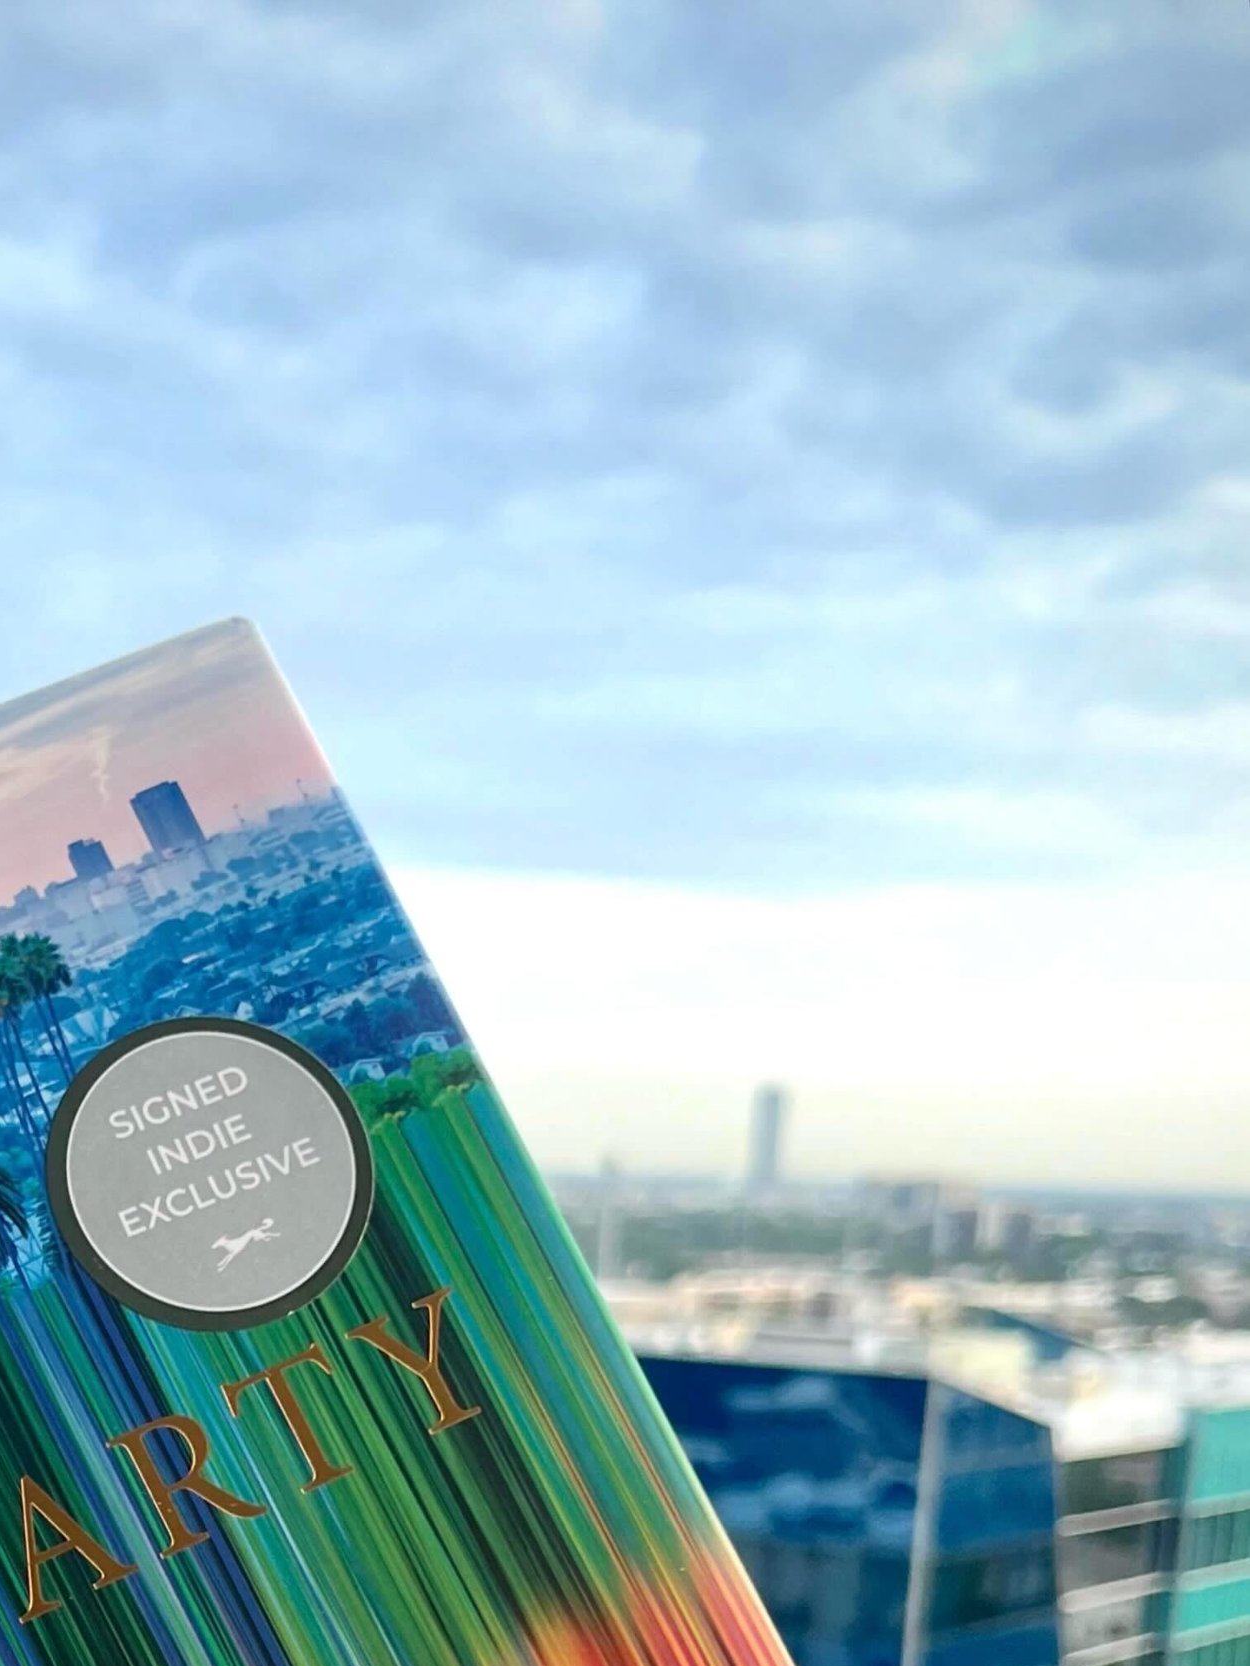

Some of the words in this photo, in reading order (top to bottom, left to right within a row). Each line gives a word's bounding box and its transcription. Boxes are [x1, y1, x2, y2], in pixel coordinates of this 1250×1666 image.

[109, 1066, 248, 1139] SIGNED
[147, 1114, 252, 1174] INDIE
[118, 1138, 320, 1237] EXCLUSIVE
